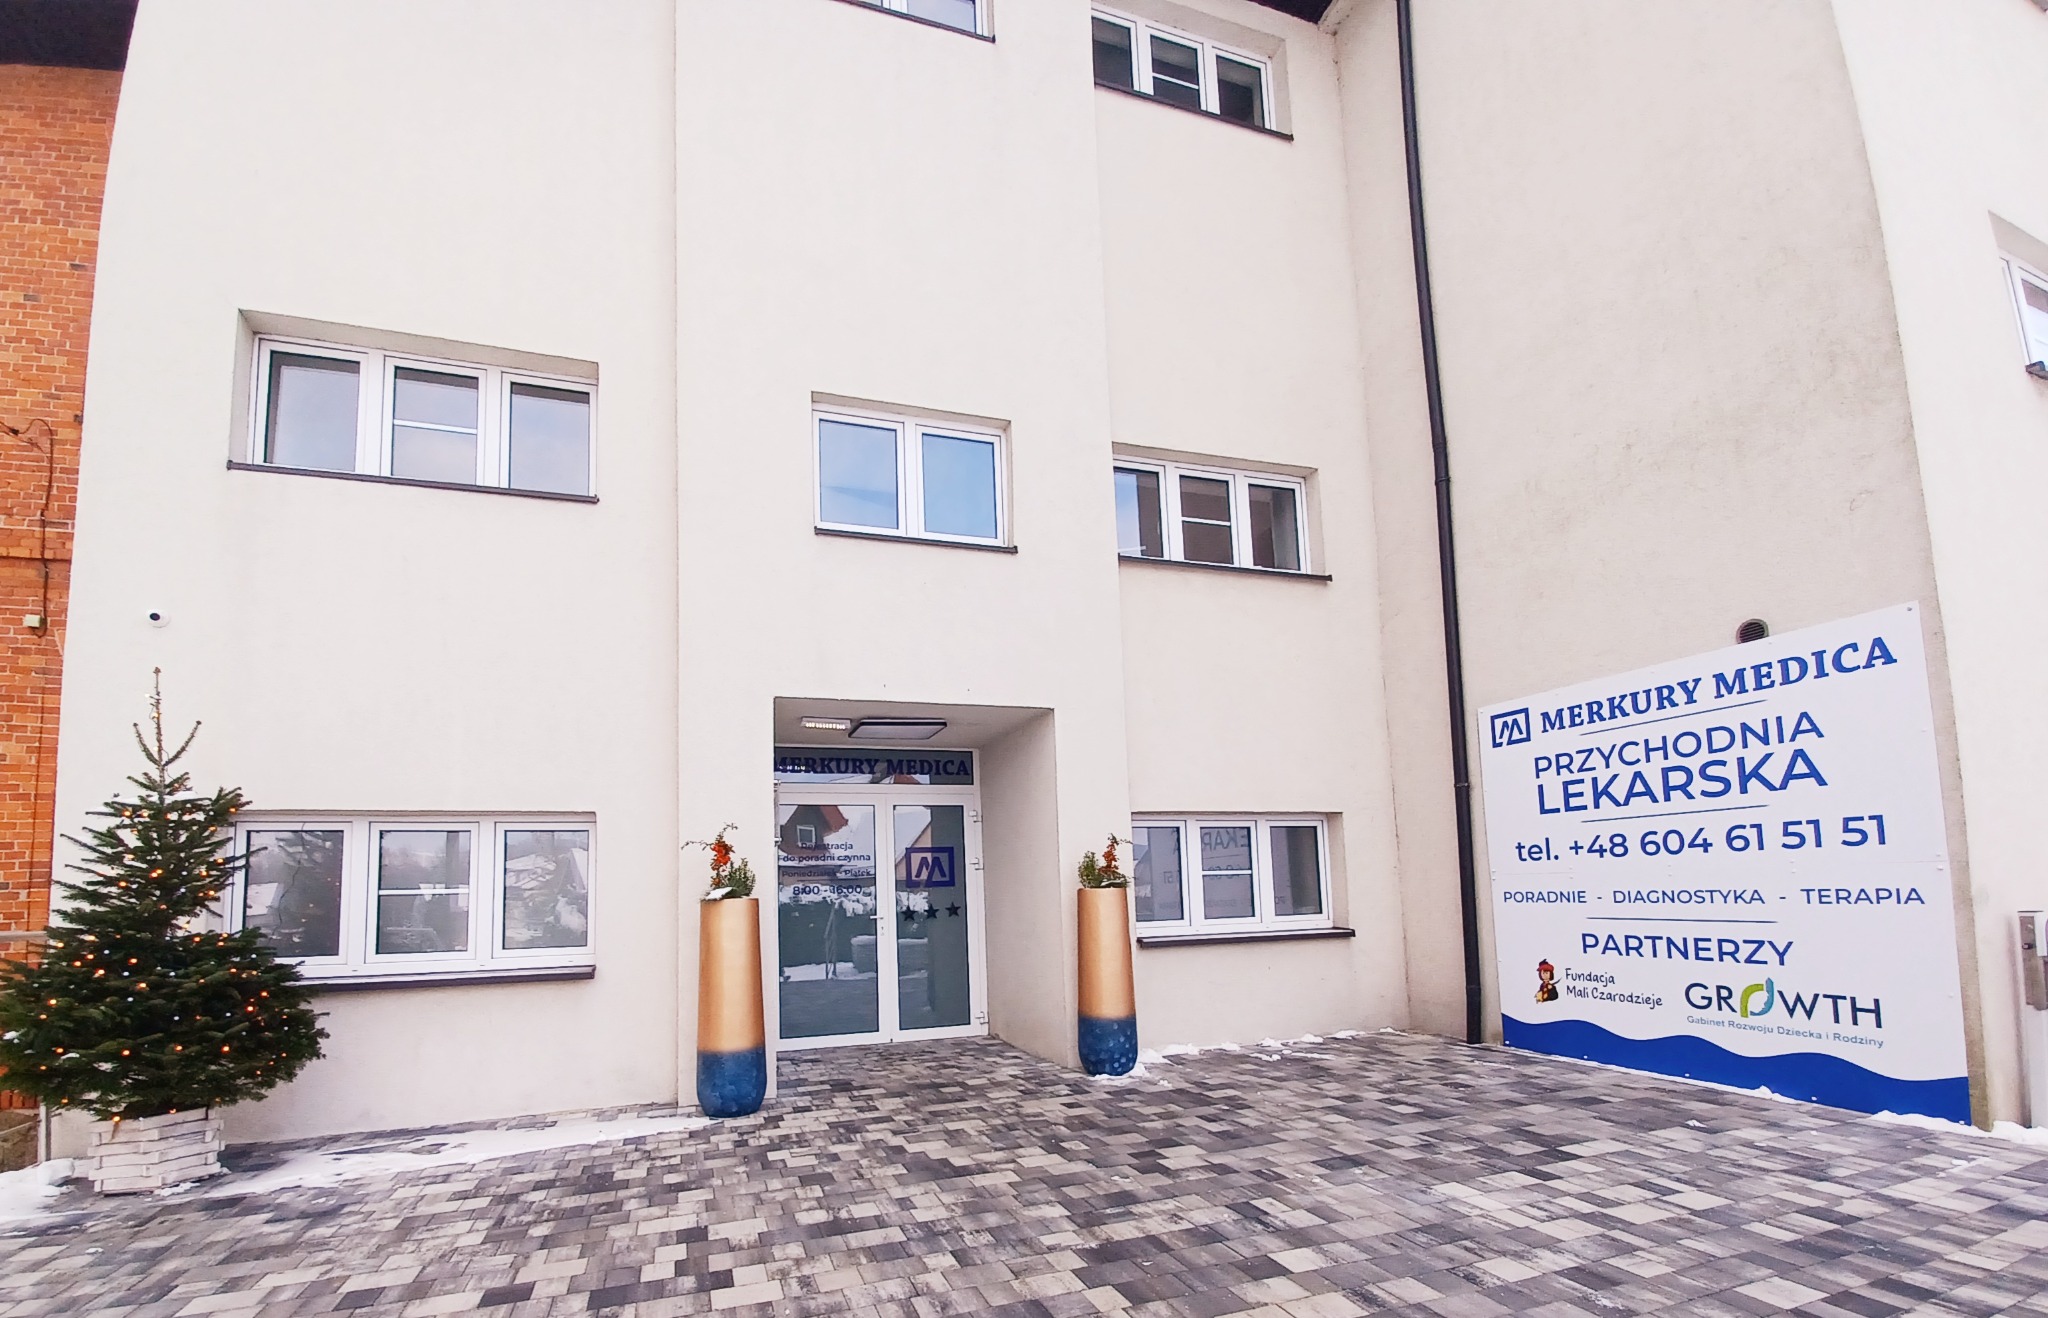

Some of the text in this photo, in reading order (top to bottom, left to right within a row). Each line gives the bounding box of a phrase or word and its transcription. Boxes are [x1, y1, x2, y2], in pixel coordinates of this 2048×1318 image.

[1539, 636, 1898, 734] MERKURY MEDICA
[1533, 711, 1825, 780] PRZYCHODNIA
[774, 756, 970, 776] MERKURY MEDICA
[1537, 748, 1829, 816] LEKARSKA
[1515, 814, 1888, 862] tel. +48 604 61 51 51
[783, 853, 871, 863] do poradni czynna
[1503, 890, 1588, 904] PORADNIE
[1612, 889, 1766, 905] DIAGNOSTYKA
[1799, 887, 1926, 905] TERAPIA
[1580, 932, 1794, 967] PARTNERZY
[1564, 967, 1616, 988] Fundacja
[1566, 985, 1663, 1010] Mali Czarodzieje
[1684, 977, 1883, 1029] GROWTH
[1686, 1015, 1725, 1028] Gabinet
[1727, 1020, 1774, 1035] Rozwoju
[1776, 1026, 1823, 1040] Dziecka
[1832, 1032, 1884, 1049] Rodziny
